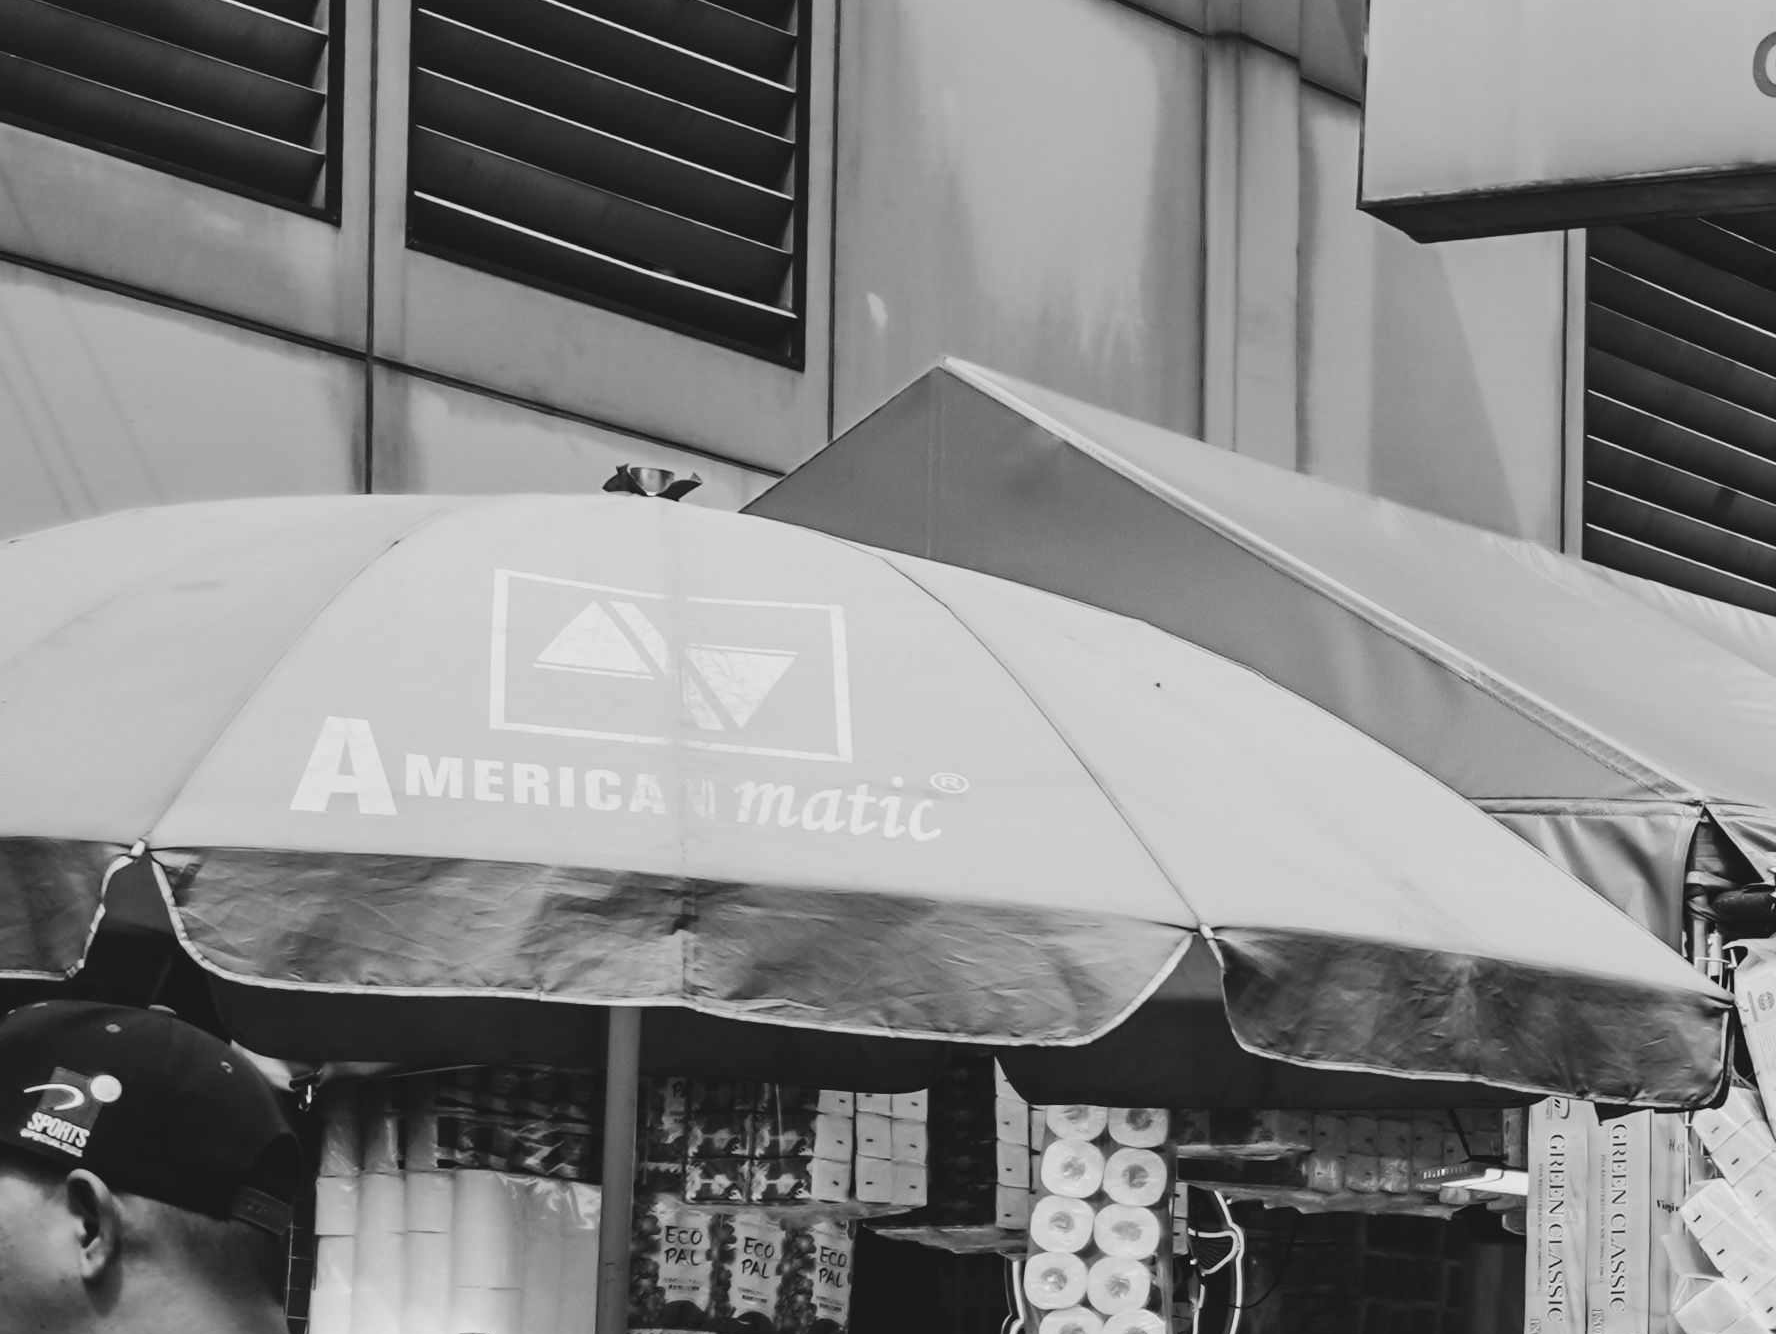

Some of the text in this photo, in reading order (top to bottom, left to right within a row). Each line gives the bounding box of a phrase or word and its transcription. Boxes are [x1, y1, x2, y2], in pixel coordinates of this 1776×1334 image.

[289, 715, 716, 819] AMERICAN
[27, 1112, 91, 1148] SPORTS
[1610, 1123, 1628, 1206] GREEN
[664, 1225, 703, 1246] ECO
[1547, 1133, 1566, 1322] GREEN CLASSIC
[664, 1247, 701, 1267] PAL
[743, 1236, 775, 1259] ECO
[819, 1245, 848, 1268] ECO
[741, 1258, 771, 1279] PAL
[1609, 1213, 1628, 1313] CLASSIC
[818, 1267, 844, 1289] PAL
